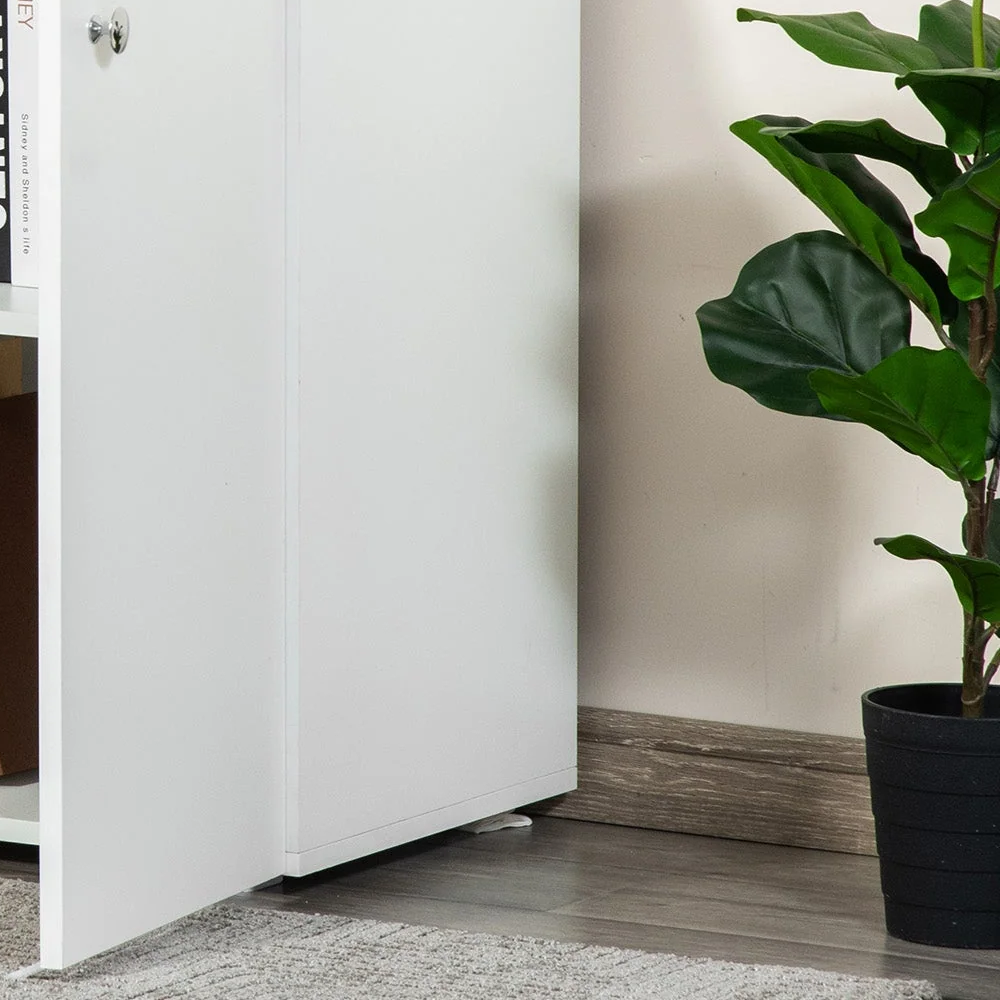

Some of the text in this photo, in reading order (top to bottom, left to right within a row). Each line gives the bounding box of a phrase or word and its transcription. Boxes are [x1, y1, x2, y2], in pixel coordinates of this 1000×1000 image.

[20, 113, 30, 150] Sidney
[21, 154, 30, 175] and
[21, 179, 30, 223] Sheldon
[22, 237, 31, 255] life
